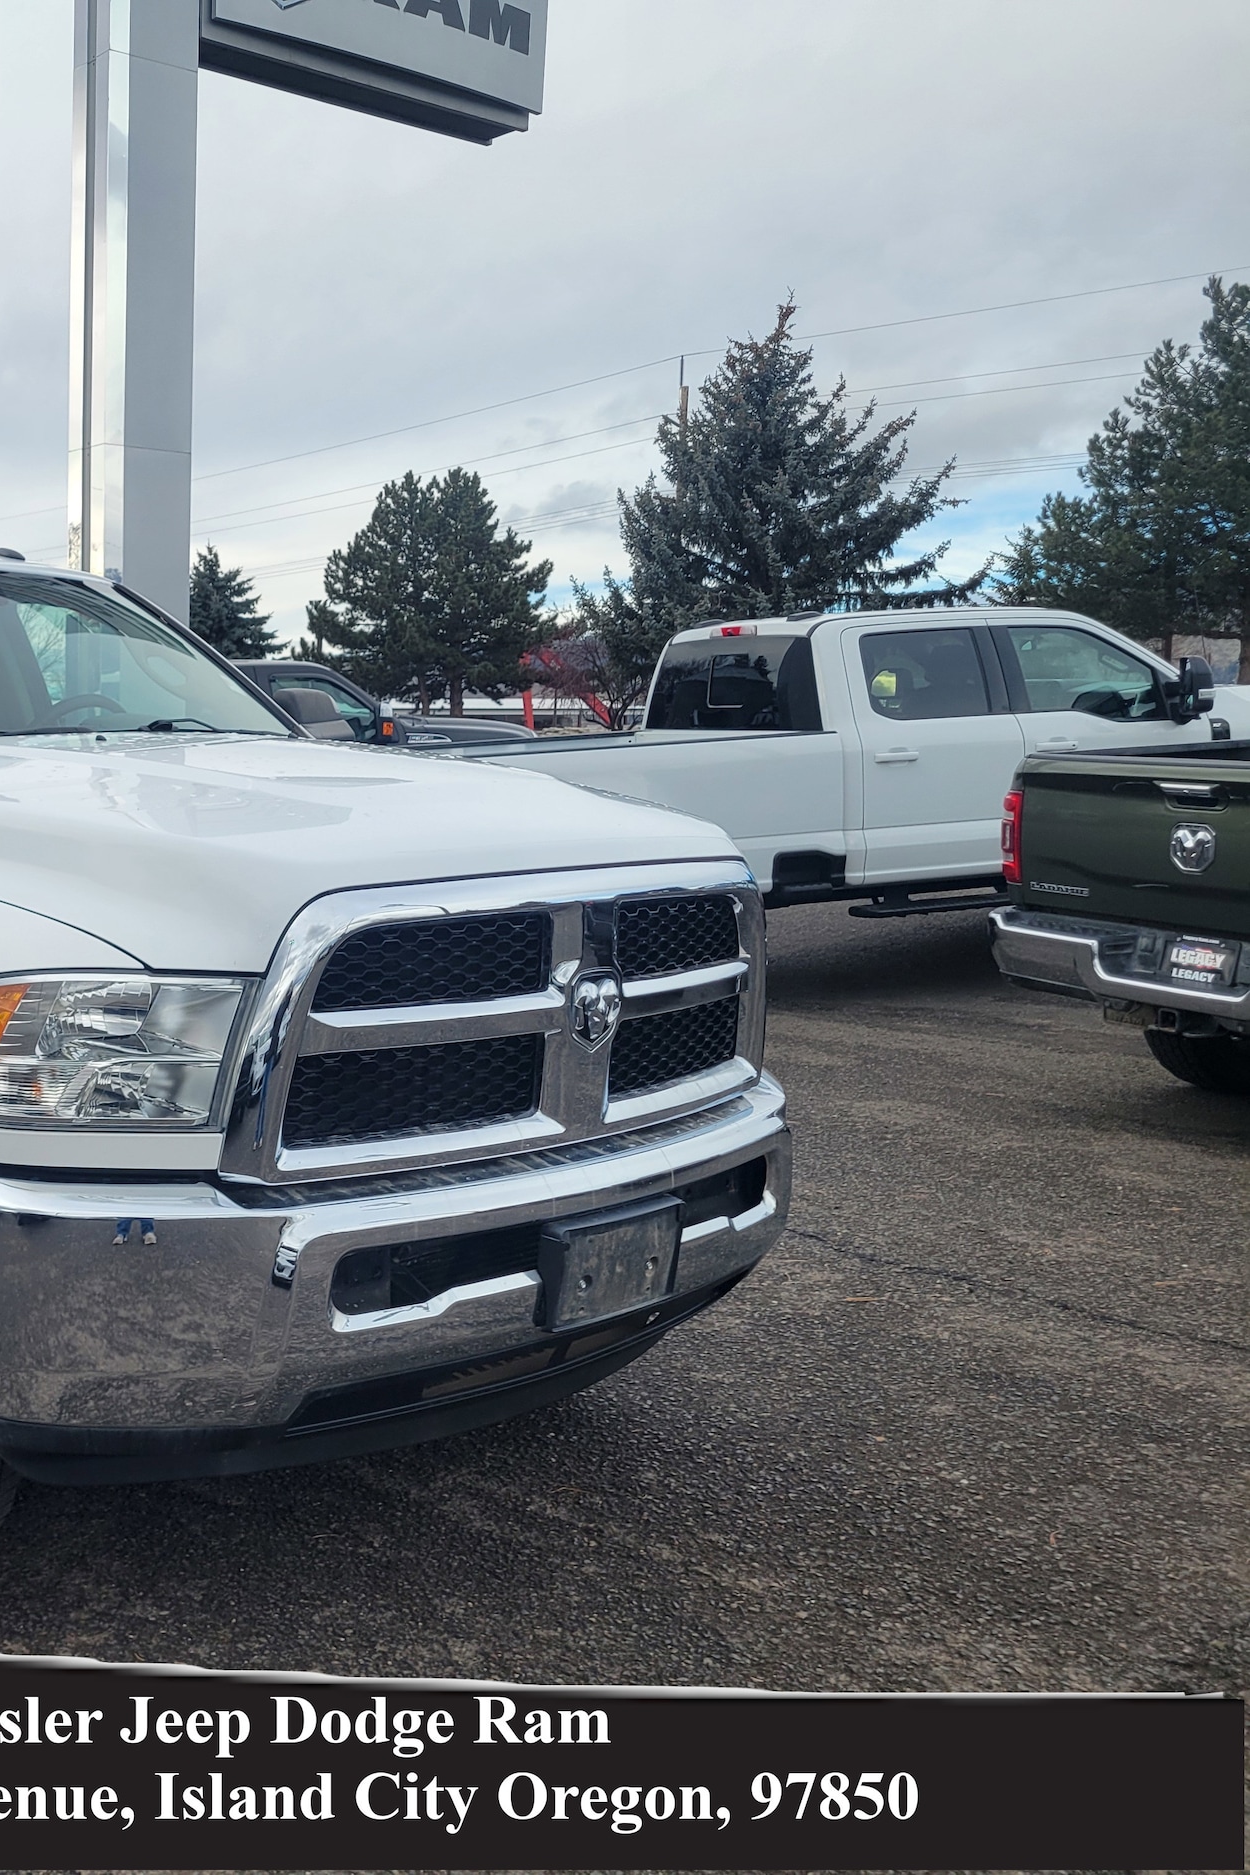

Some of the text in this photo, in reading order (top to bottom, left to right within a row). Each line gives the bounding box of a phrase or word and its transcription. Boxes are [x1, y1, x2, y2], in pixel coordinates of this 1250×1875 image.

[373, 0, 531, 56] AM
[1170, 947, 1227, 969] LEGACY
[1171, 966, 1216, 983] LEGACY
